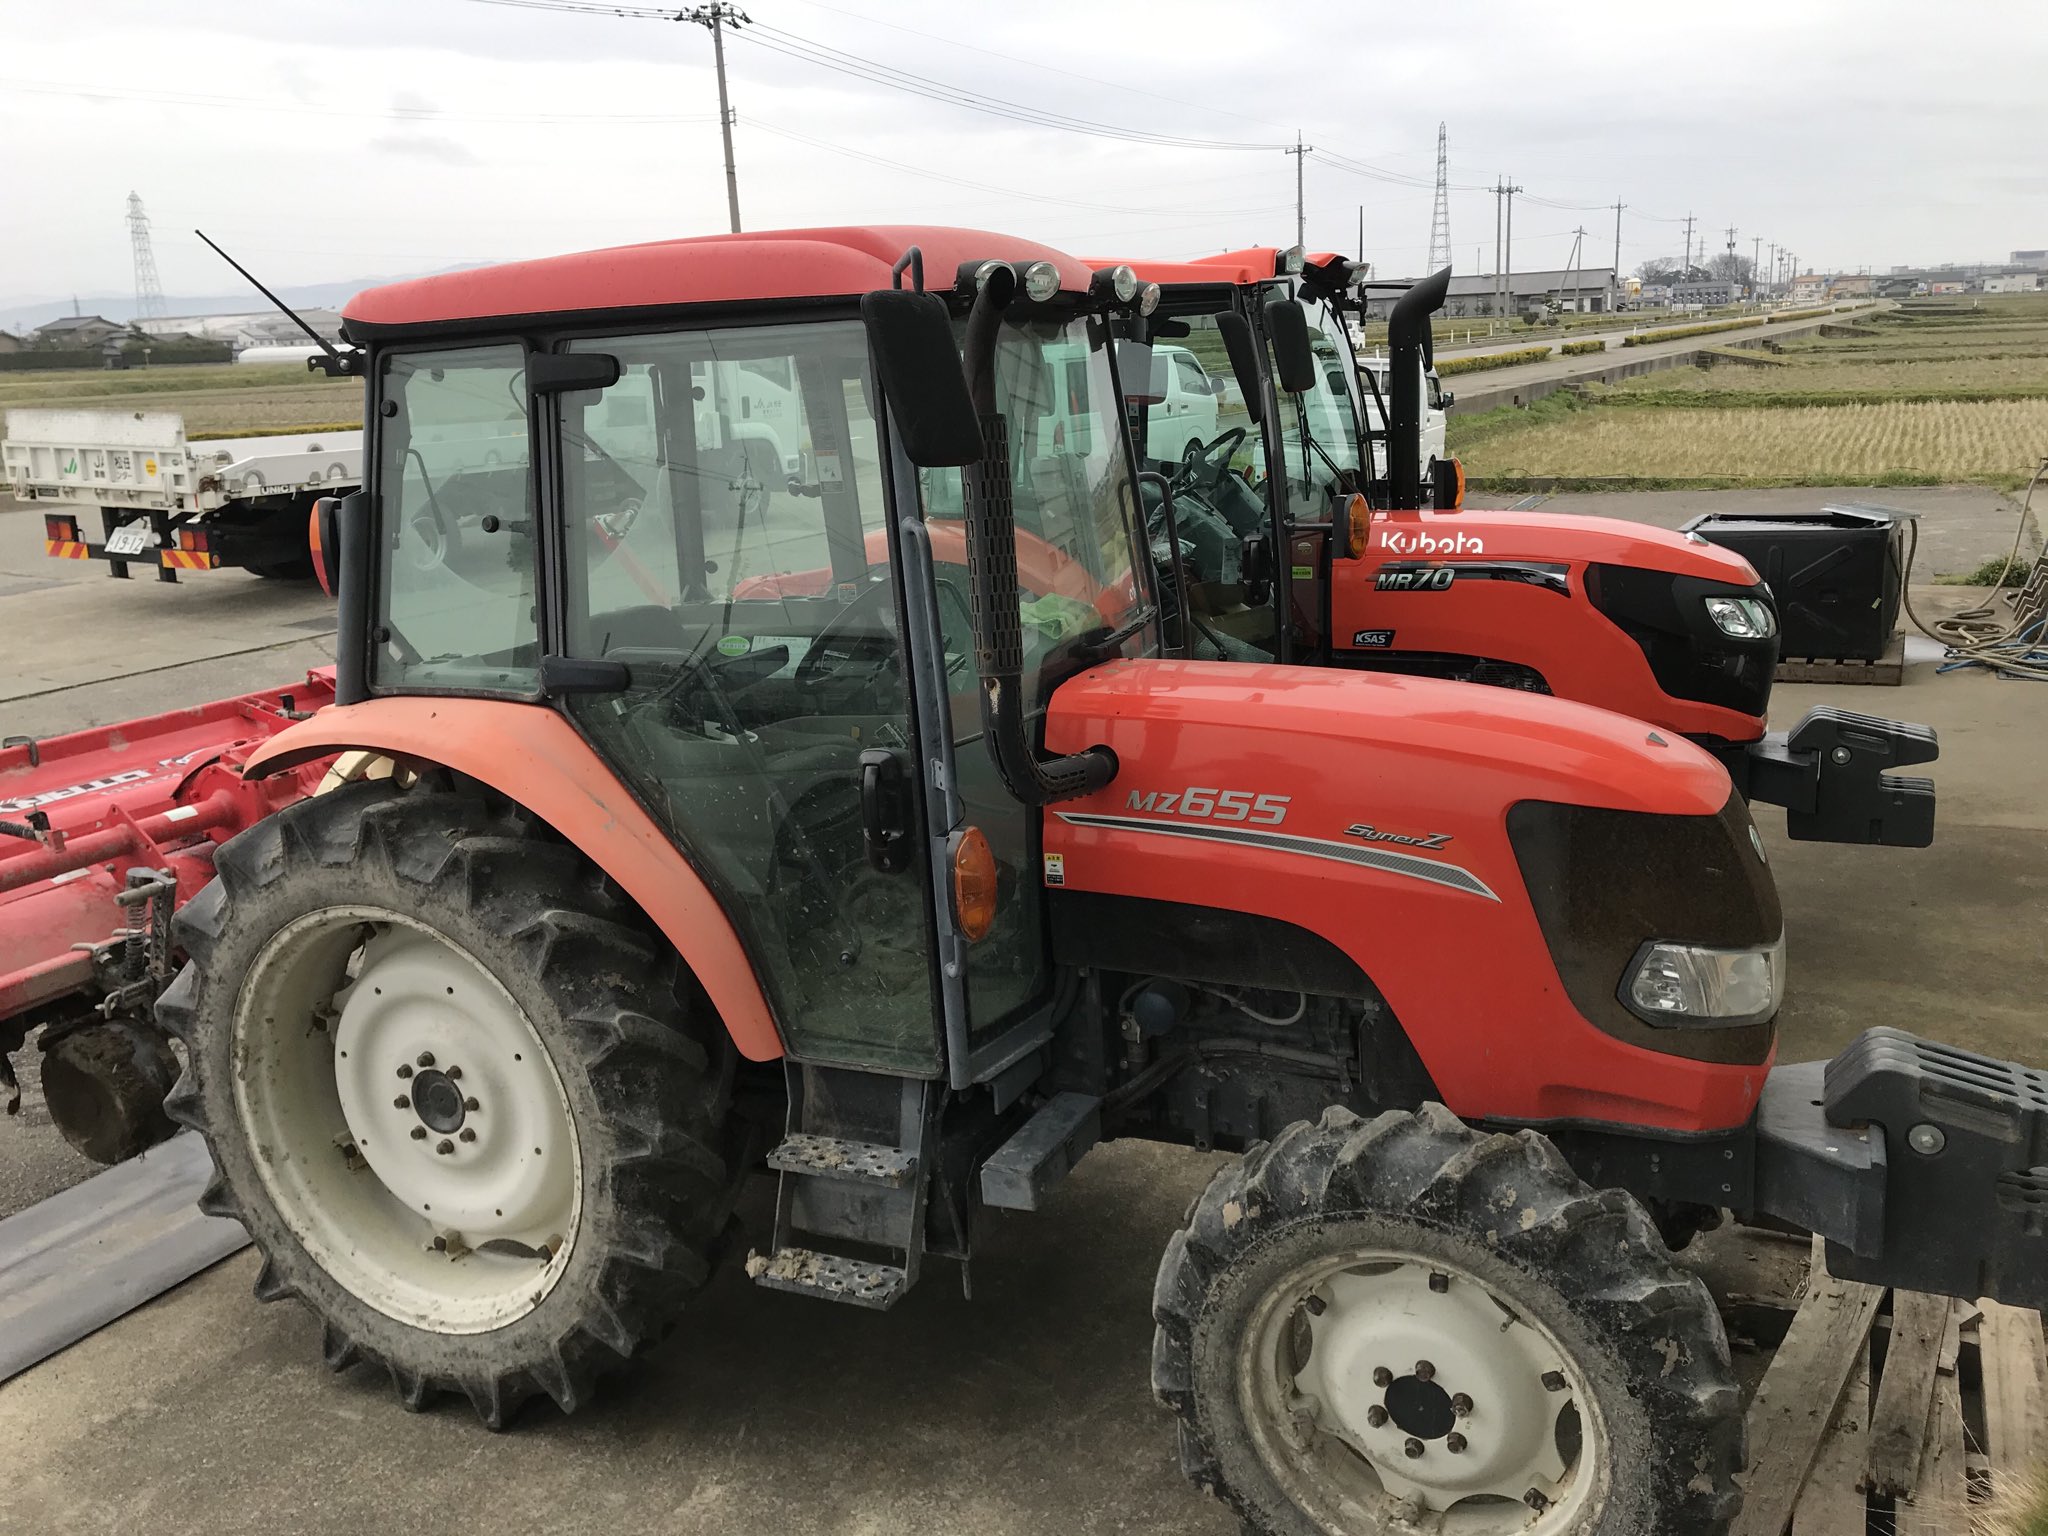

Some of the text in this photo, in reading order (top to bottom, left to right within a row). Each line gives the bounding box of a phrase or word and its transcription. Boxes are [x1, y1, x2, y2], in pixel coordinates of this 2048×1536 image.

[261, 484, 290, 495] UNIC
[1381, 532, 1484, 554] Kubota
[1375, 568, 1455, 590] MR70
[1355, 632, 1387, 644] KSAS
[1126, 787, 1292, 825] MZ655
[1343, 823, 1454, 851] SynerZ
